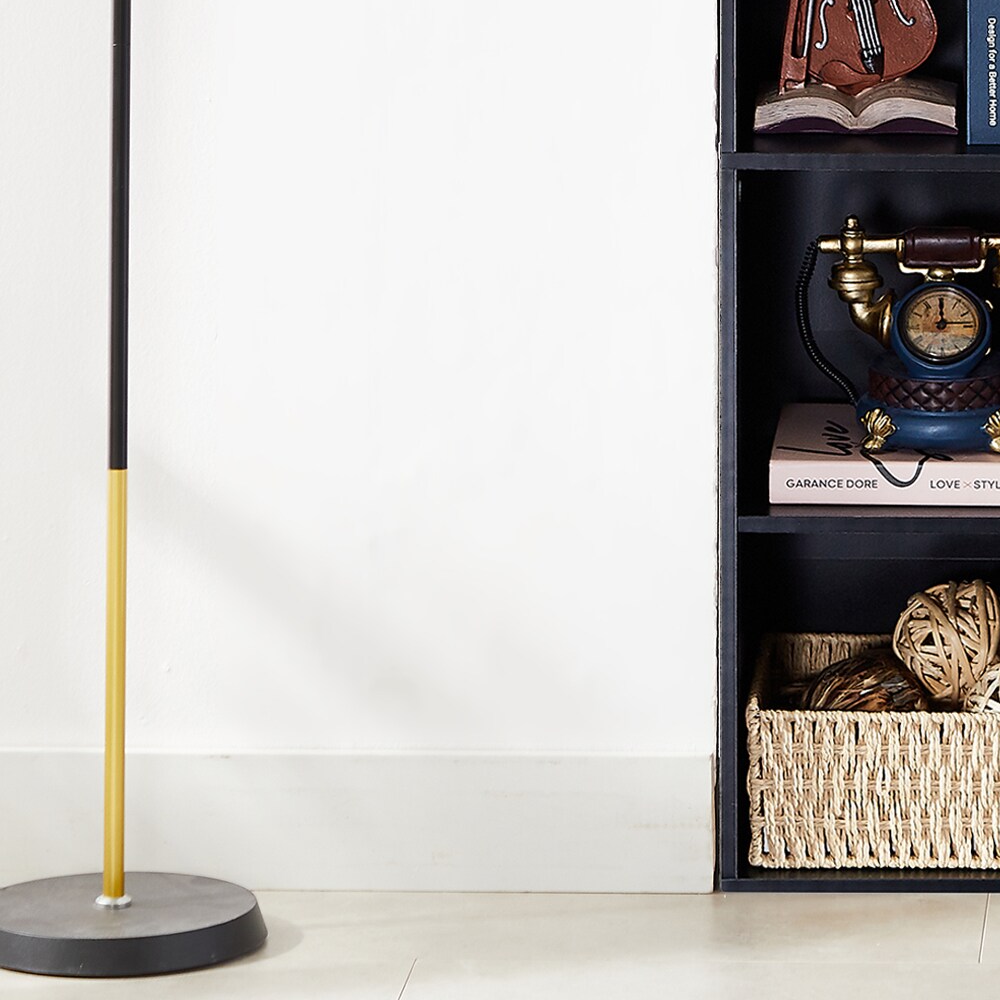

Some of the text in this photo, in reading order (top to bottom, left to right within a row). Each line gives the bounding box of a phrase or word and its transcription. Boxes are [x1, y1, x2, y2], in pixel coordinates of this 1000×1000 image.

[986, 17, 997, 48] Design
[988, 49, 998, 63] for
[988, 71, 998, 98] Better
[988, 99, 998, 126] Home
[785, 478, 878, 489] GARANCE DORE
[929, 479, 961, 490] LOVE
